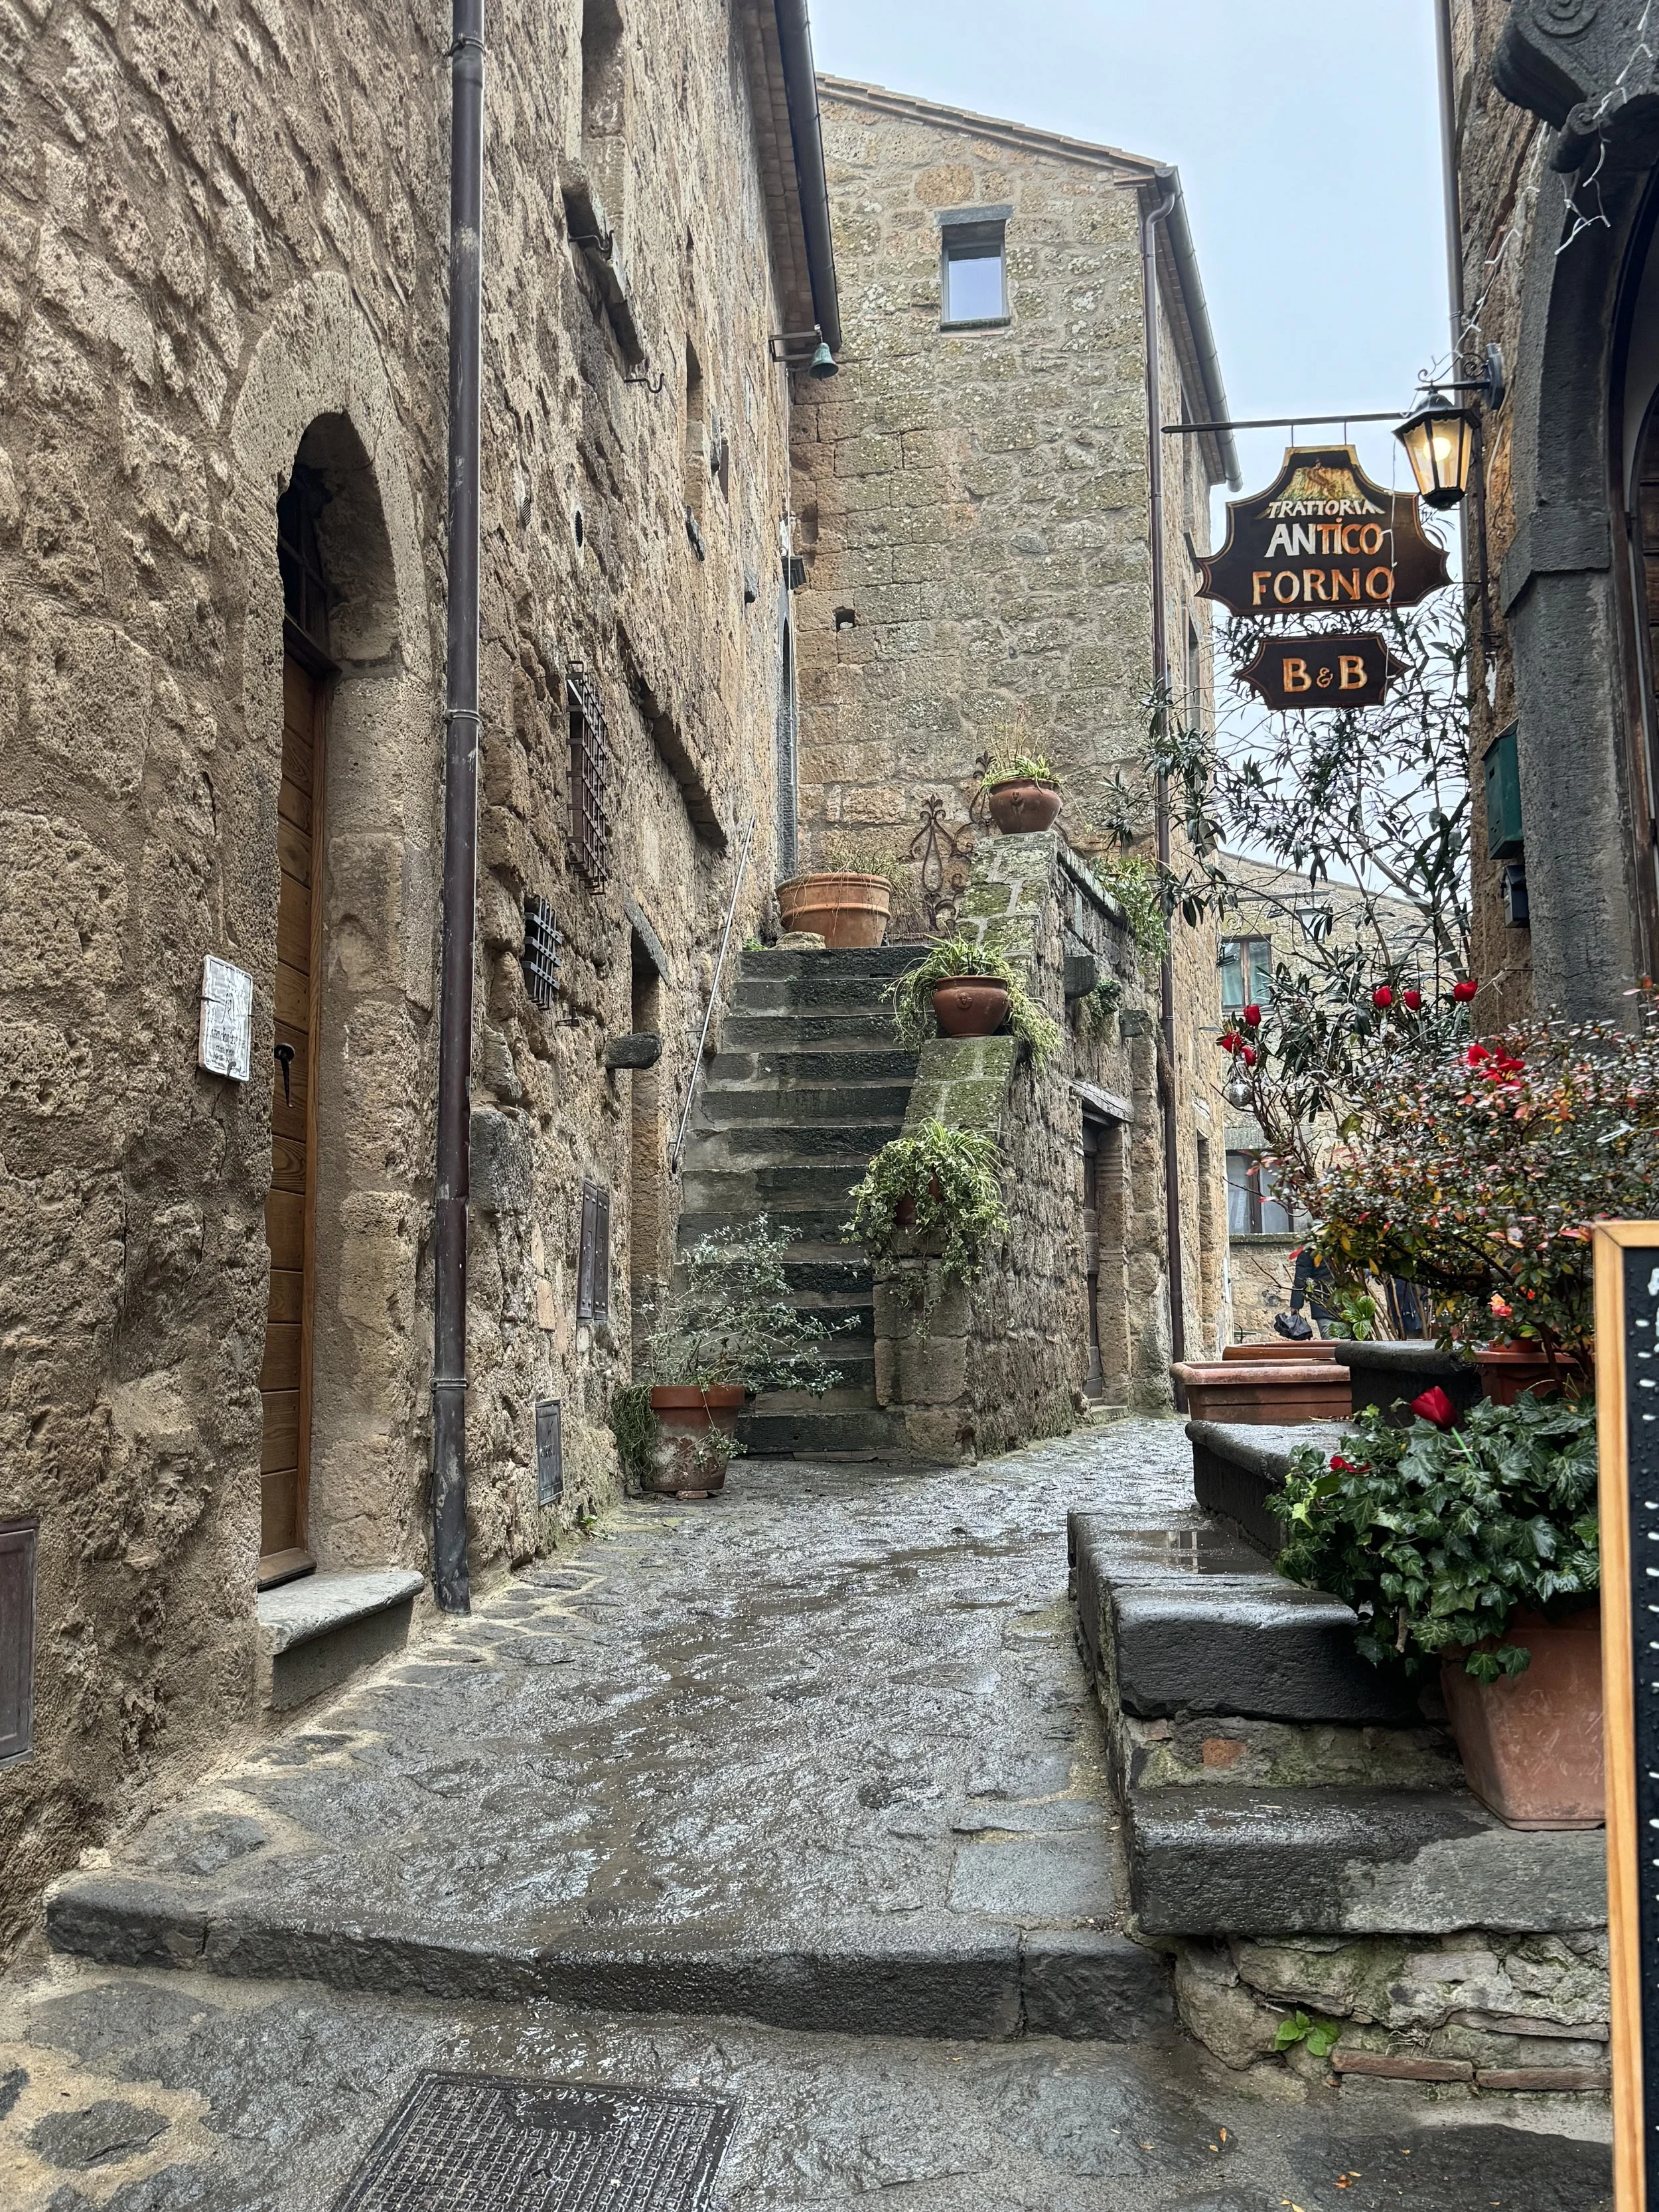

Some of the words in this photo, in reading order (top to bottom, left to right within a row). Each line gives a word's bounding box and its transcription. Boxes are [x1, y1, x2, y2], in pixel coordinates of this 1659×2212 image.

[1267, 499, 1376, 519] TRATTORIA
[1263, 518, 1384, 557] ANTICO
[1252, 567, 1394, 605] FORNO
